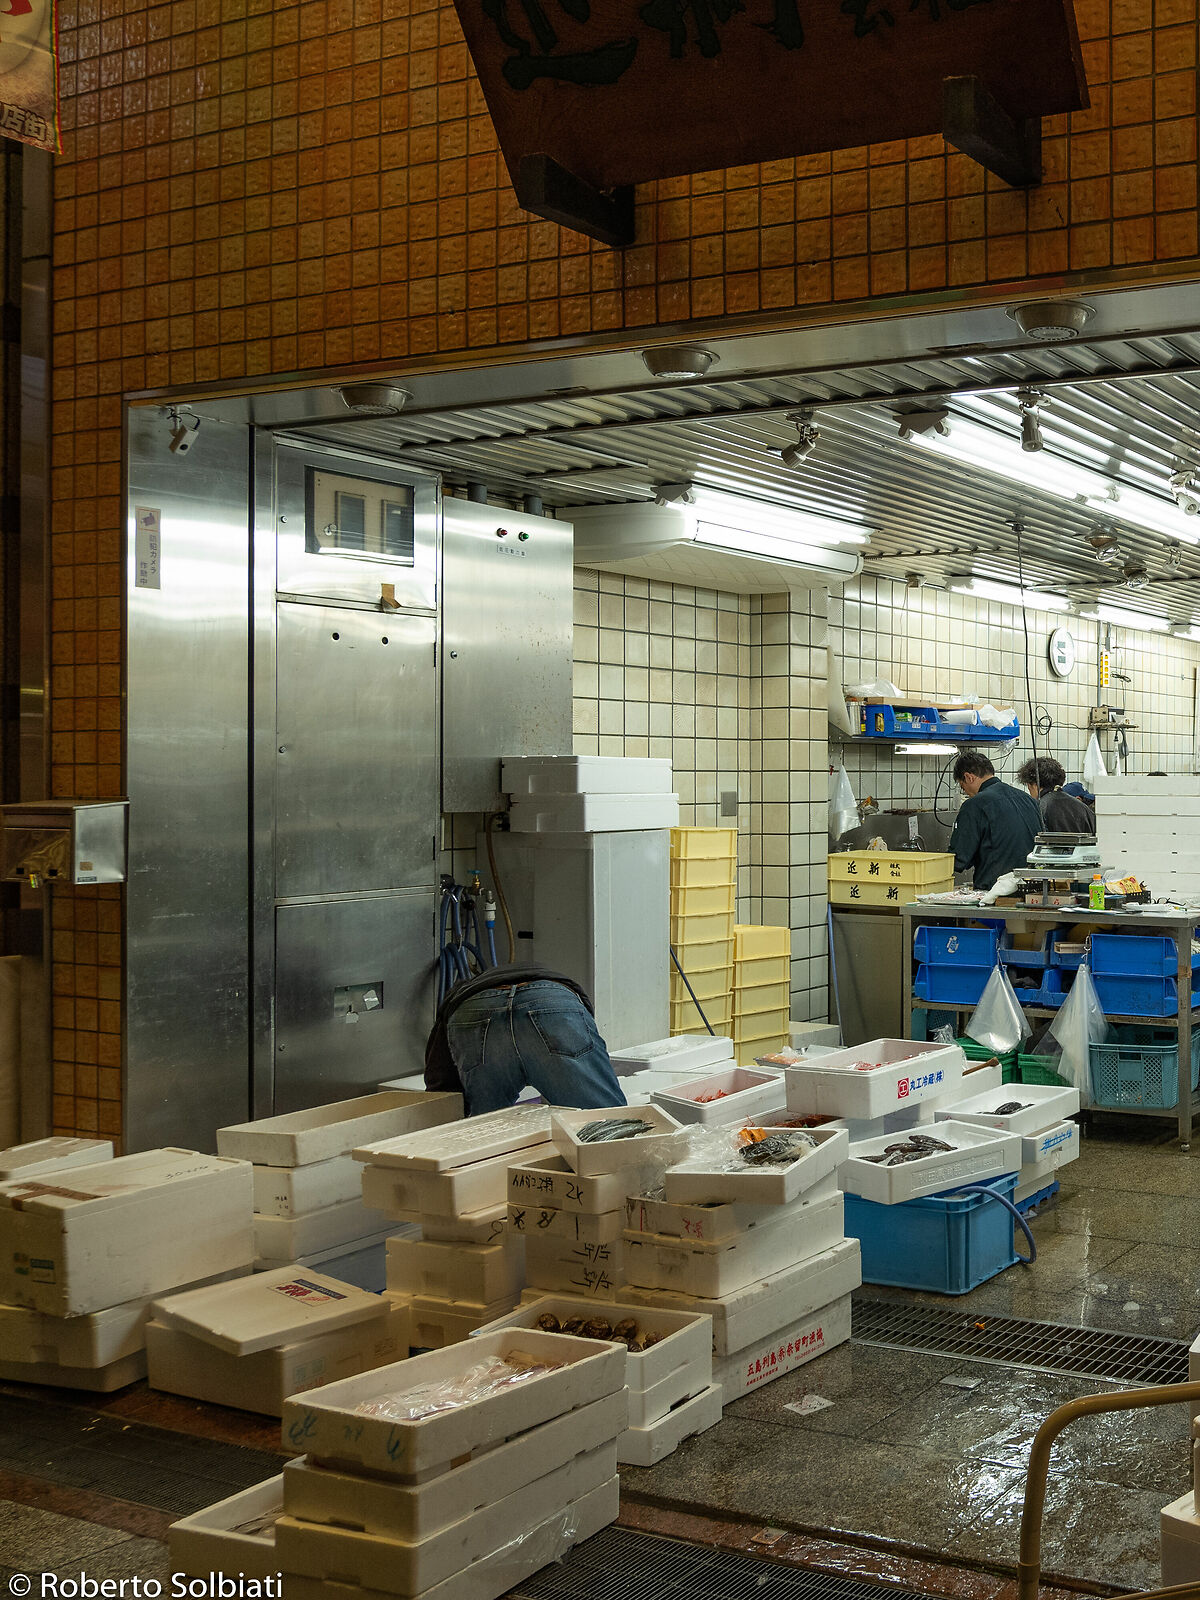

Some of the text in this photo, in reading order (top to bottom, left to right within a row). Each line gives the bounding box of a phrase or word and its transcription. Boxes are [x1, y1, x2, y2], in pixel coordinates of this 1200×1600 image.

[149, 534, 157, 574] 防犯カメラ
[847, 860, 880, 876] 近新
[849, 884, 899, 901] 近新
[747, 1352, 777, 1377] 五島列島
